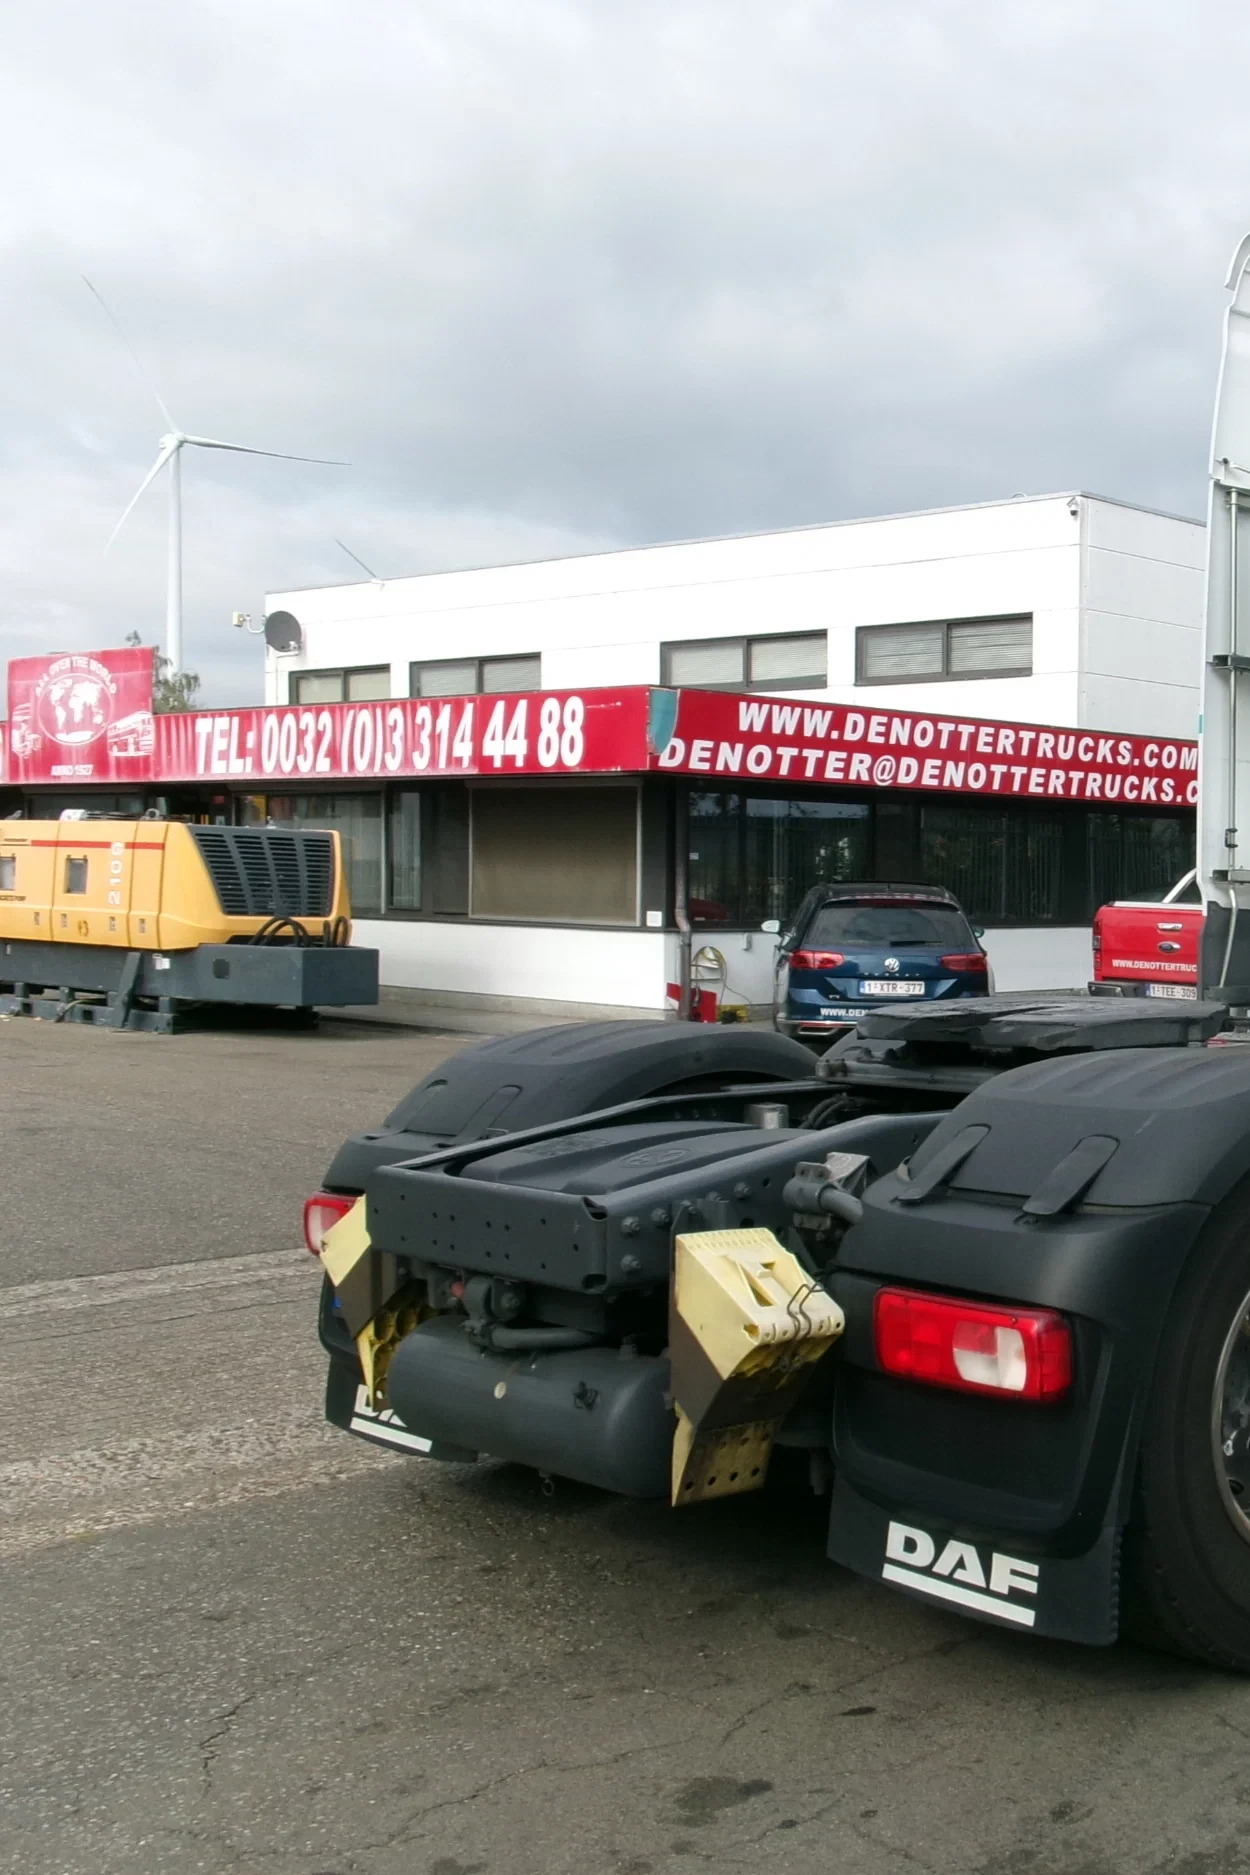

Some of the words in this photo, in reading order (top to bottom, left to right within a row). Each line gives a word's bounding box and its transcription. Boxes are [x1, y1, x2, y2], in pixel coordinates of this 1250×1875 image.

[195, 716, 254, 774] TEL:
[261, 709, 332, 773] 0032
[341, 706, 404, 773] (0)3
[412, 702, 475, 770] 314
[482, 699, 528, 768] 44
[537, 696, 585, 768] 88
[738, 701, 1198, 771] WWW.DENOTTERTRUCKS.COM
[1111, 959, 1198, 972] WWW.DENOTTERTRUC
[867, 983, 923, 993] 1-XTR-377
[1152, 985, 1196, 998] 1-TEE-309
[886, 1520, 1040, 1596] DAF
